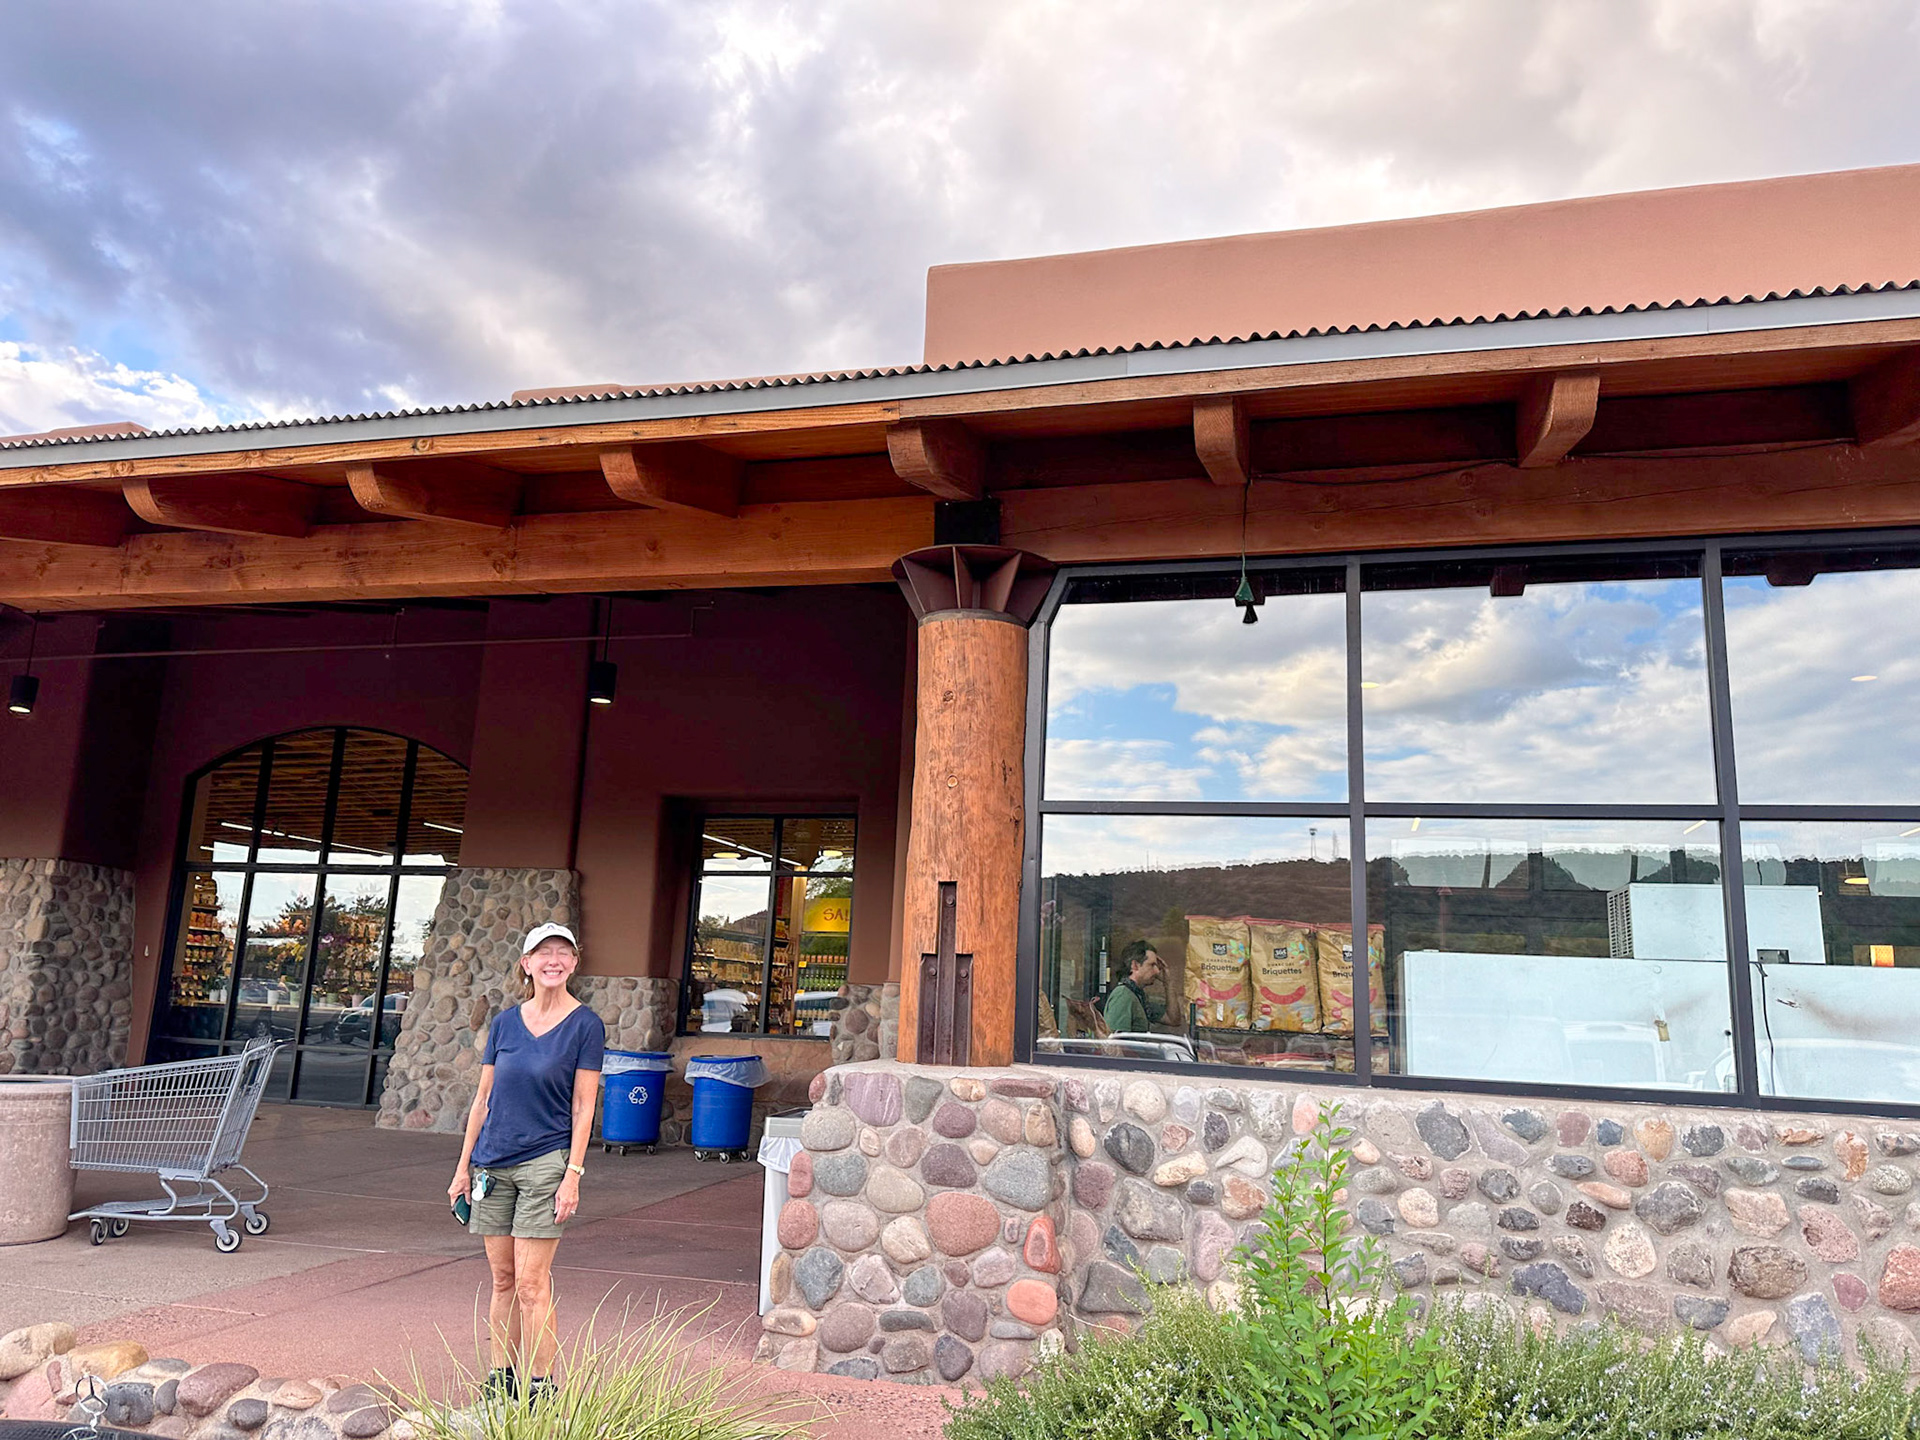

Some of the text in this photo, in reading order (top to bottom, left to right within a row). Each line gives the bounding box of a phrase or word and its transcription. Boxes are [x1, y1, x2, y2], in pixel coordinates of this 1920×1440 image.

[823, 908, 850, 922] SAL
[1201, 963, 1239, 972] Briquettes
[1262, 967, 1302, 976] Briquettes
